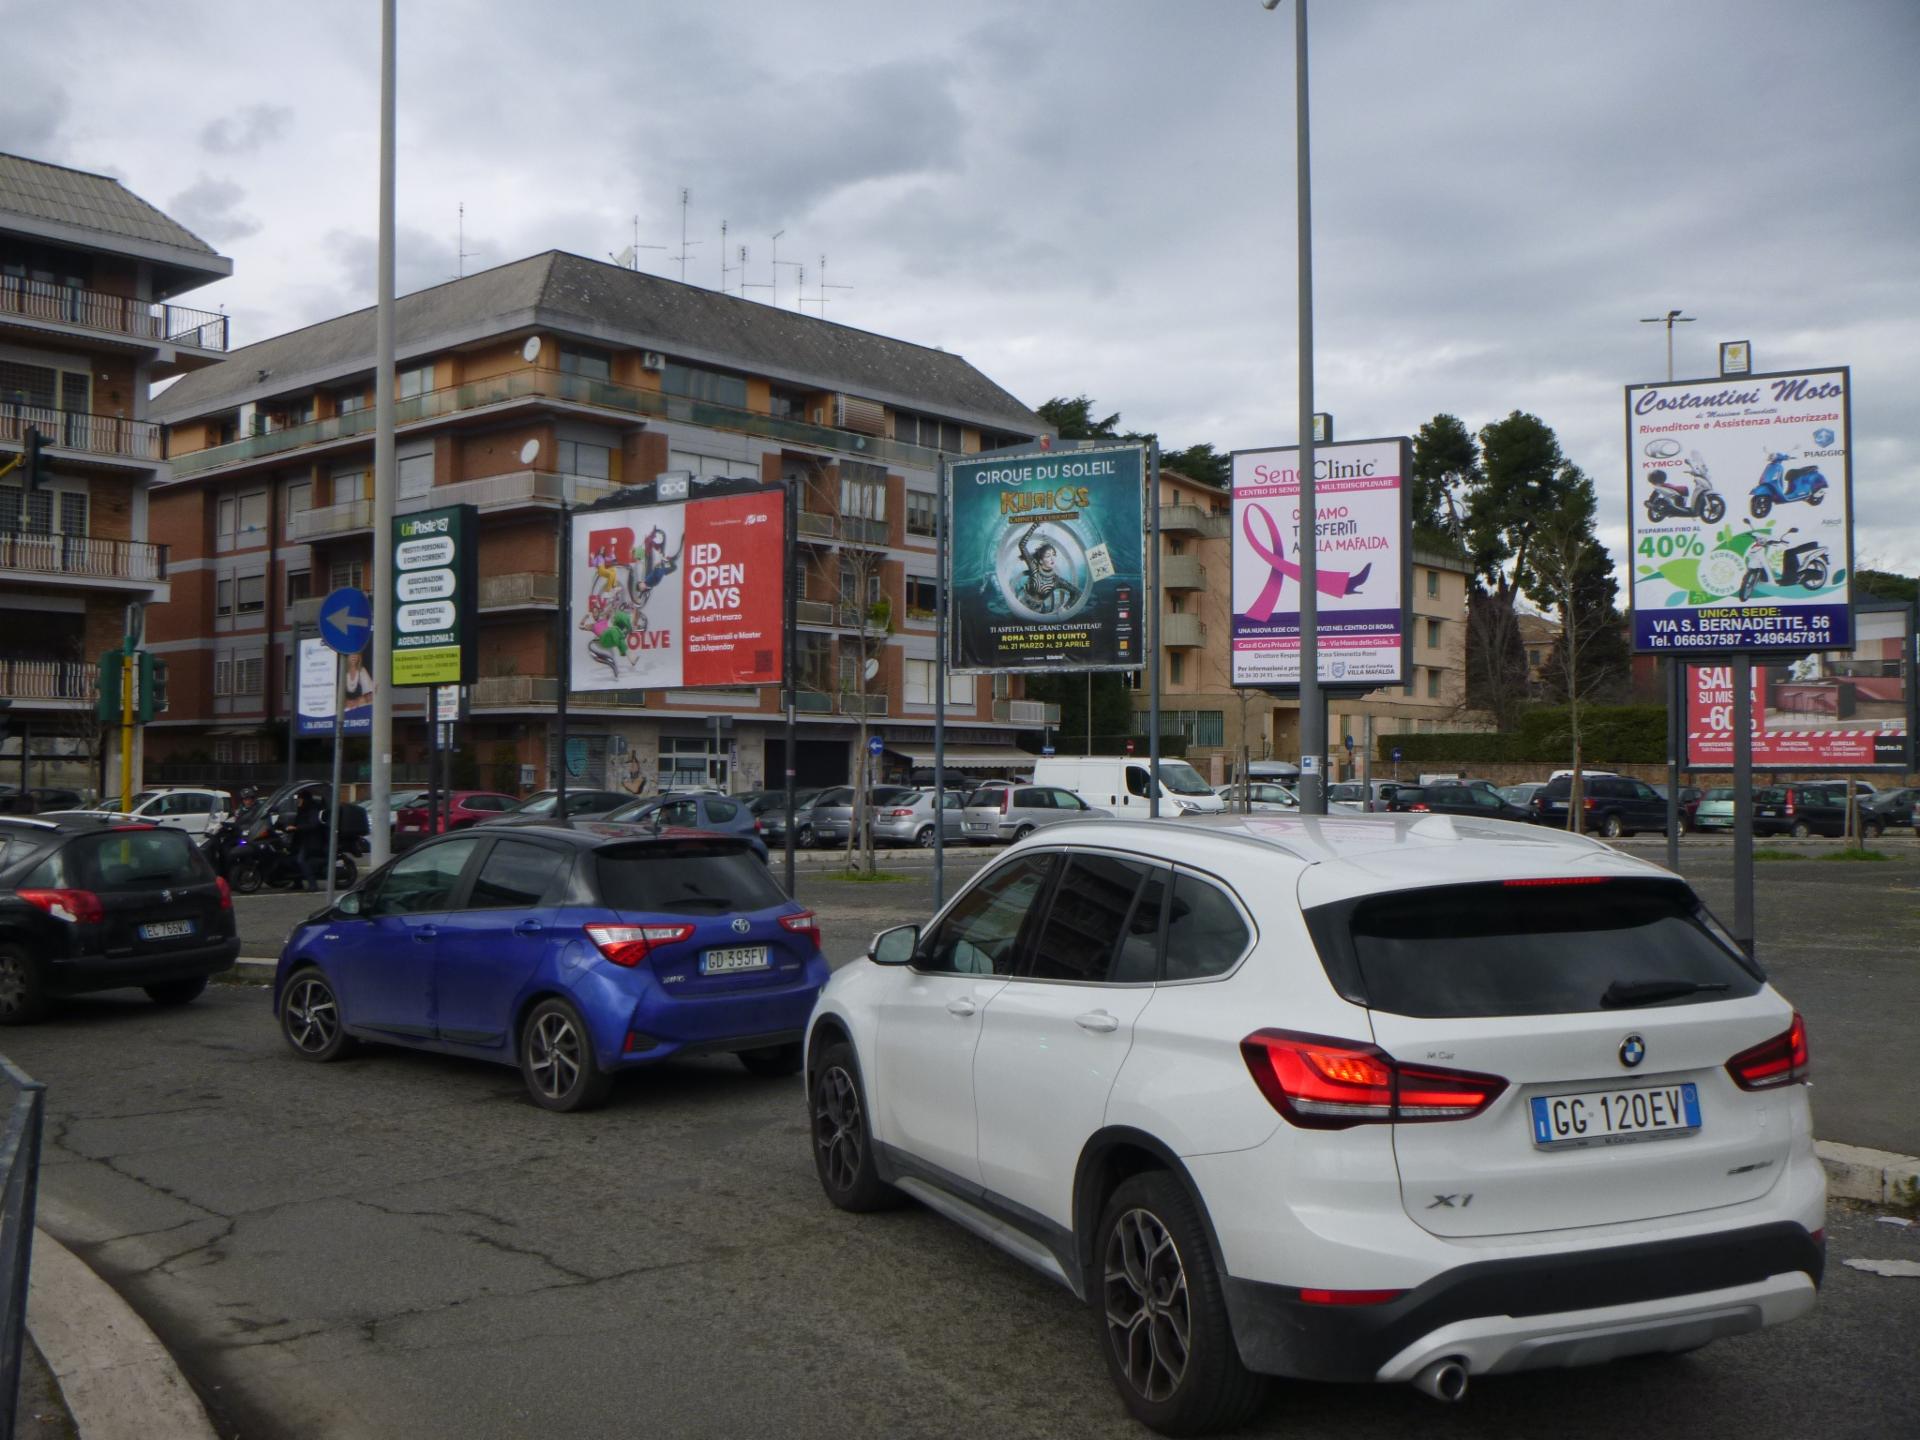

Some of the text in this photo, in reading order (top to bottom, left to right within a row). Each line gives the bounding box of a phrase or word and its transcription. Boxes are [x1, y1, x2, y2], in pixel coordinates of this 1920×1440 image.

[1635, 379, 1843, 415] Costantini Moto
[1639, 419, 1700, 434] Rivenditore
[1713, 416, 1770, 429] Assistenza
[1774, 412, 1839, 425] Autorizzata
[1804, 449, 1845, 458] PIAGGIO
[1643, 460, 1683, 469] KYMCO
[976, 461, 1115, 486] CIRQUE DU SOLEIL
[1239, 488, 1268, 497] CENTRO
[1269, 487, 1277, 495] DI
[1321, 480, 1394, 491] MULTIDISCIPLINARE
[401, 519, 436, 537] UniPoste
[421, 542, 448, 551] PERSONALI
[1336, 536, 1389, 551] MAFALDA
[1638, 533, 1705, 558] 40%
[421, 552, 446, 561] CORRENTI
[691, 543, 721, 566] IED
[690, 563, 744, 588] OPEN
[415, 587, 426, 595] TUTTI
[690, 587, 740, 611] DAYS
[690, 615, 701, 623] Dal
[722, 613, 742, 622] marzo
[1698, 607, 1782, 619] UNICA SEDE:
[1653, 616, 1830, 633] VIA S. BERNADETTE, 56
[398, 636, 424, 646] AGENZIA
[424, 635, 431, 644] DI
[431, 633, 449, 643] ROMA
[690, 633, 705, 642] Corsi
[706, 632, 733, 641] Triennali
[738, 631, 761, 640] Master
[1065, 640, 1091, 648] APRILE
[1649, 635, 1671, 647] Tel.
[1674, 633, 1743, 646] 066637587
[1754, 631, 1830, 644] 3496457811
[1238, 665, 1248, 673] Per
[1248, 664, 1284, 672] informazioni
[1698, 666, 1757, 690] SALI
[1699, 690, 1713, 704] SU
[708, 946, 767, 966] GD 393FV
[1553, 1099, 1587, 1136] GG
[1600, 1090, 1680, 1131] 120EV
[1425, 1192, 1474, 1210] X1
